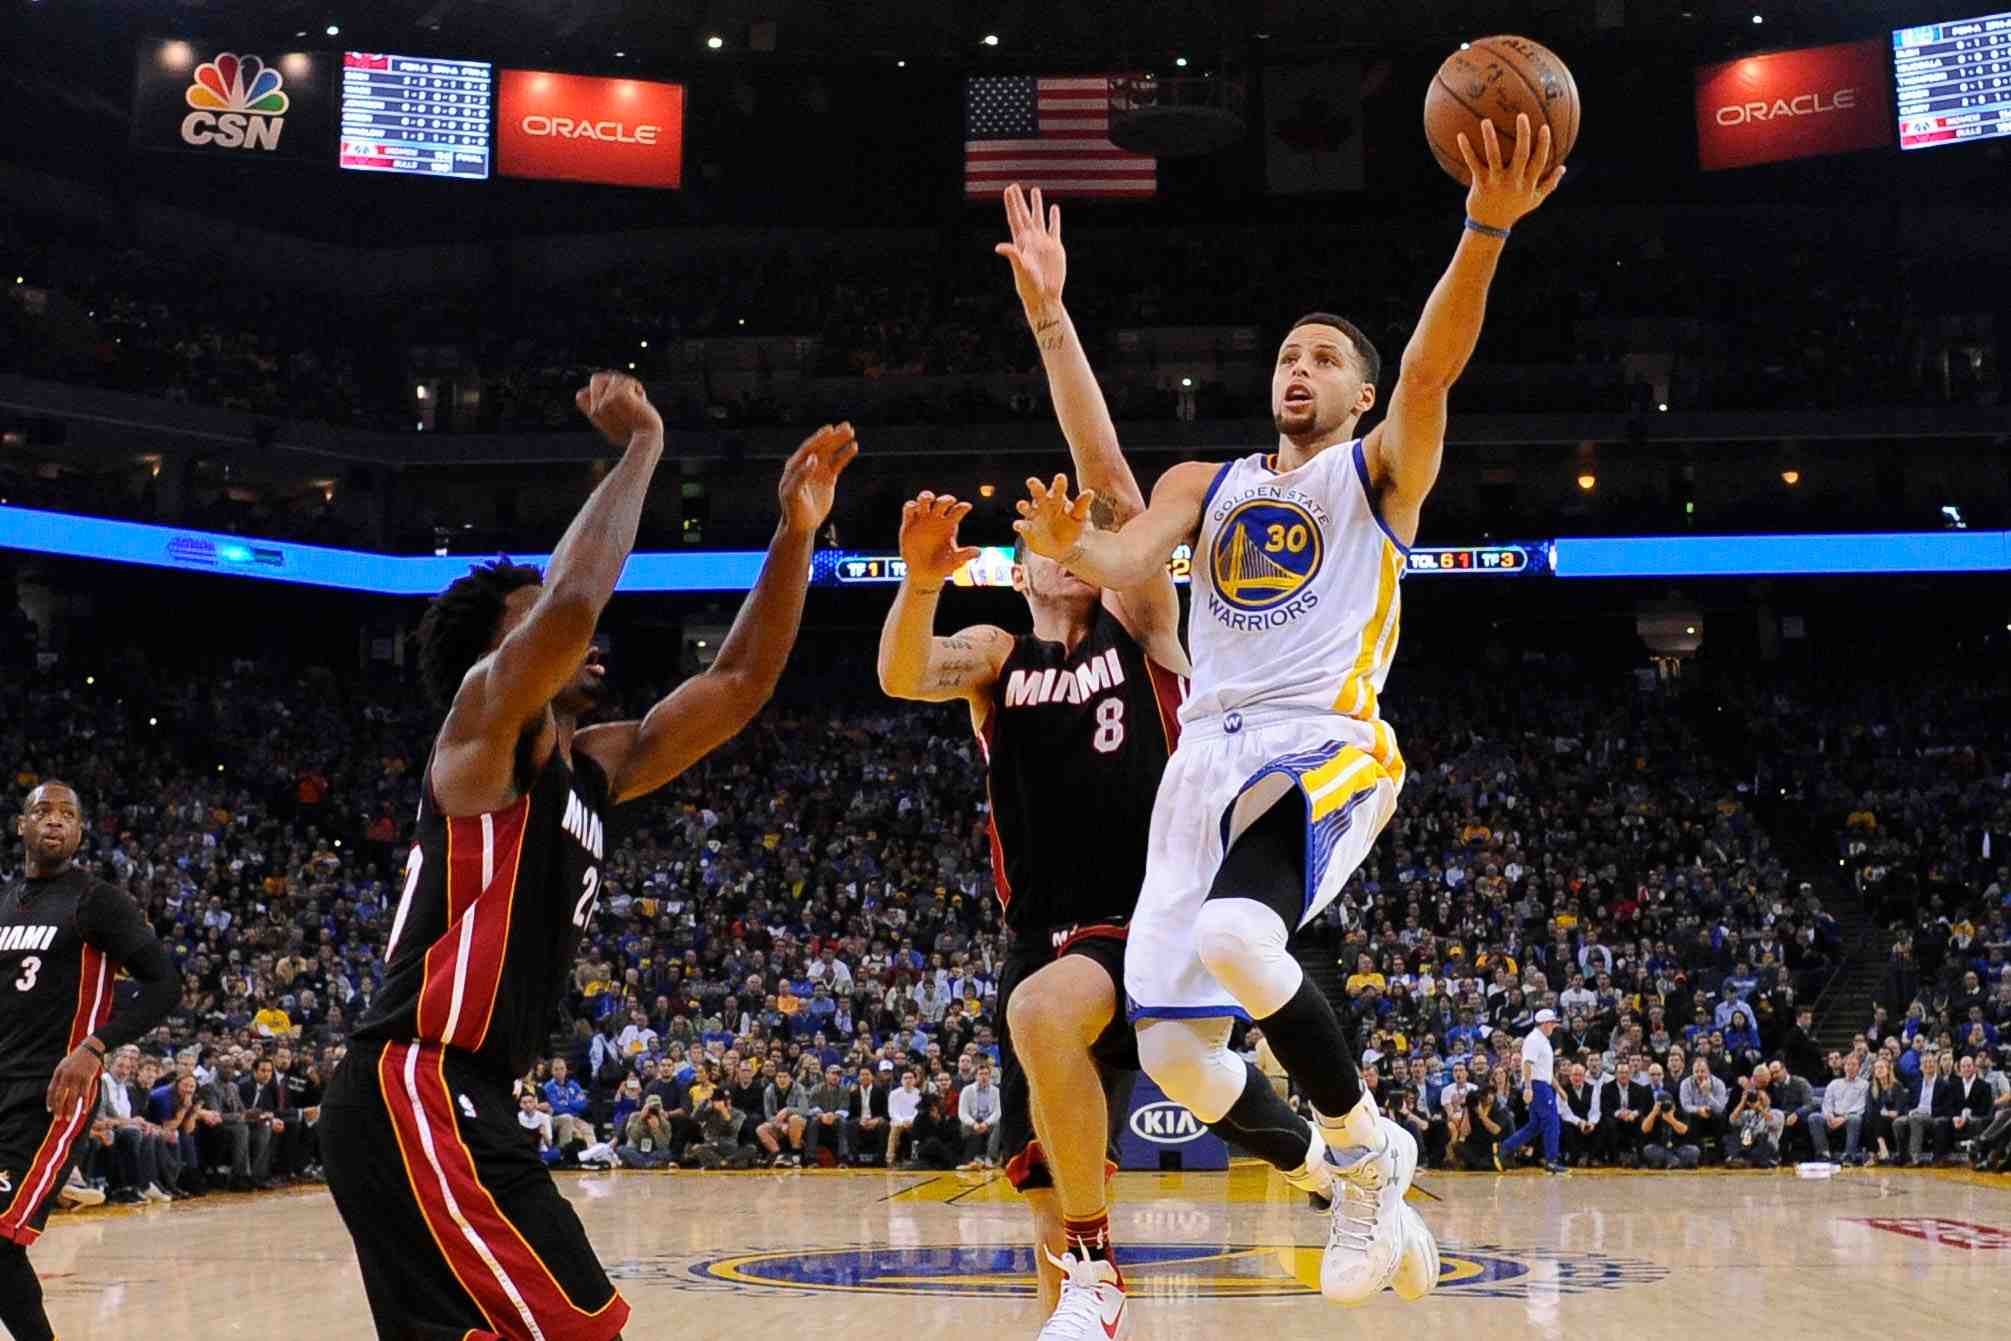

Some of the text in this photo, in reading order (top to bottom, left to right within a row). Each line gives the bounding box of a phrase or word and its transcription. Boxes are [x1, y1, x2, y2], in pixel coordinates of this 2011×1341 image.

[1716, 89, 1855, 126] ORACLE
[181, 111, 285, 150] CSN
[522, 115, 657, 145] ORACLE
[1214, 486, 1330, 525] GOLDEN STATE
[1264, 523, 1308, 552] 30
[1208, 590, 1319, 631] WARRIORS
[1005, 647, 1126, 708] MIAMI
[1093, 697, 1124, 752] 8
[0, 925, 58, 951] IAMI
[15, 955, 42, 991] 3
[1144, 1110, 1197, 1135] KIA
